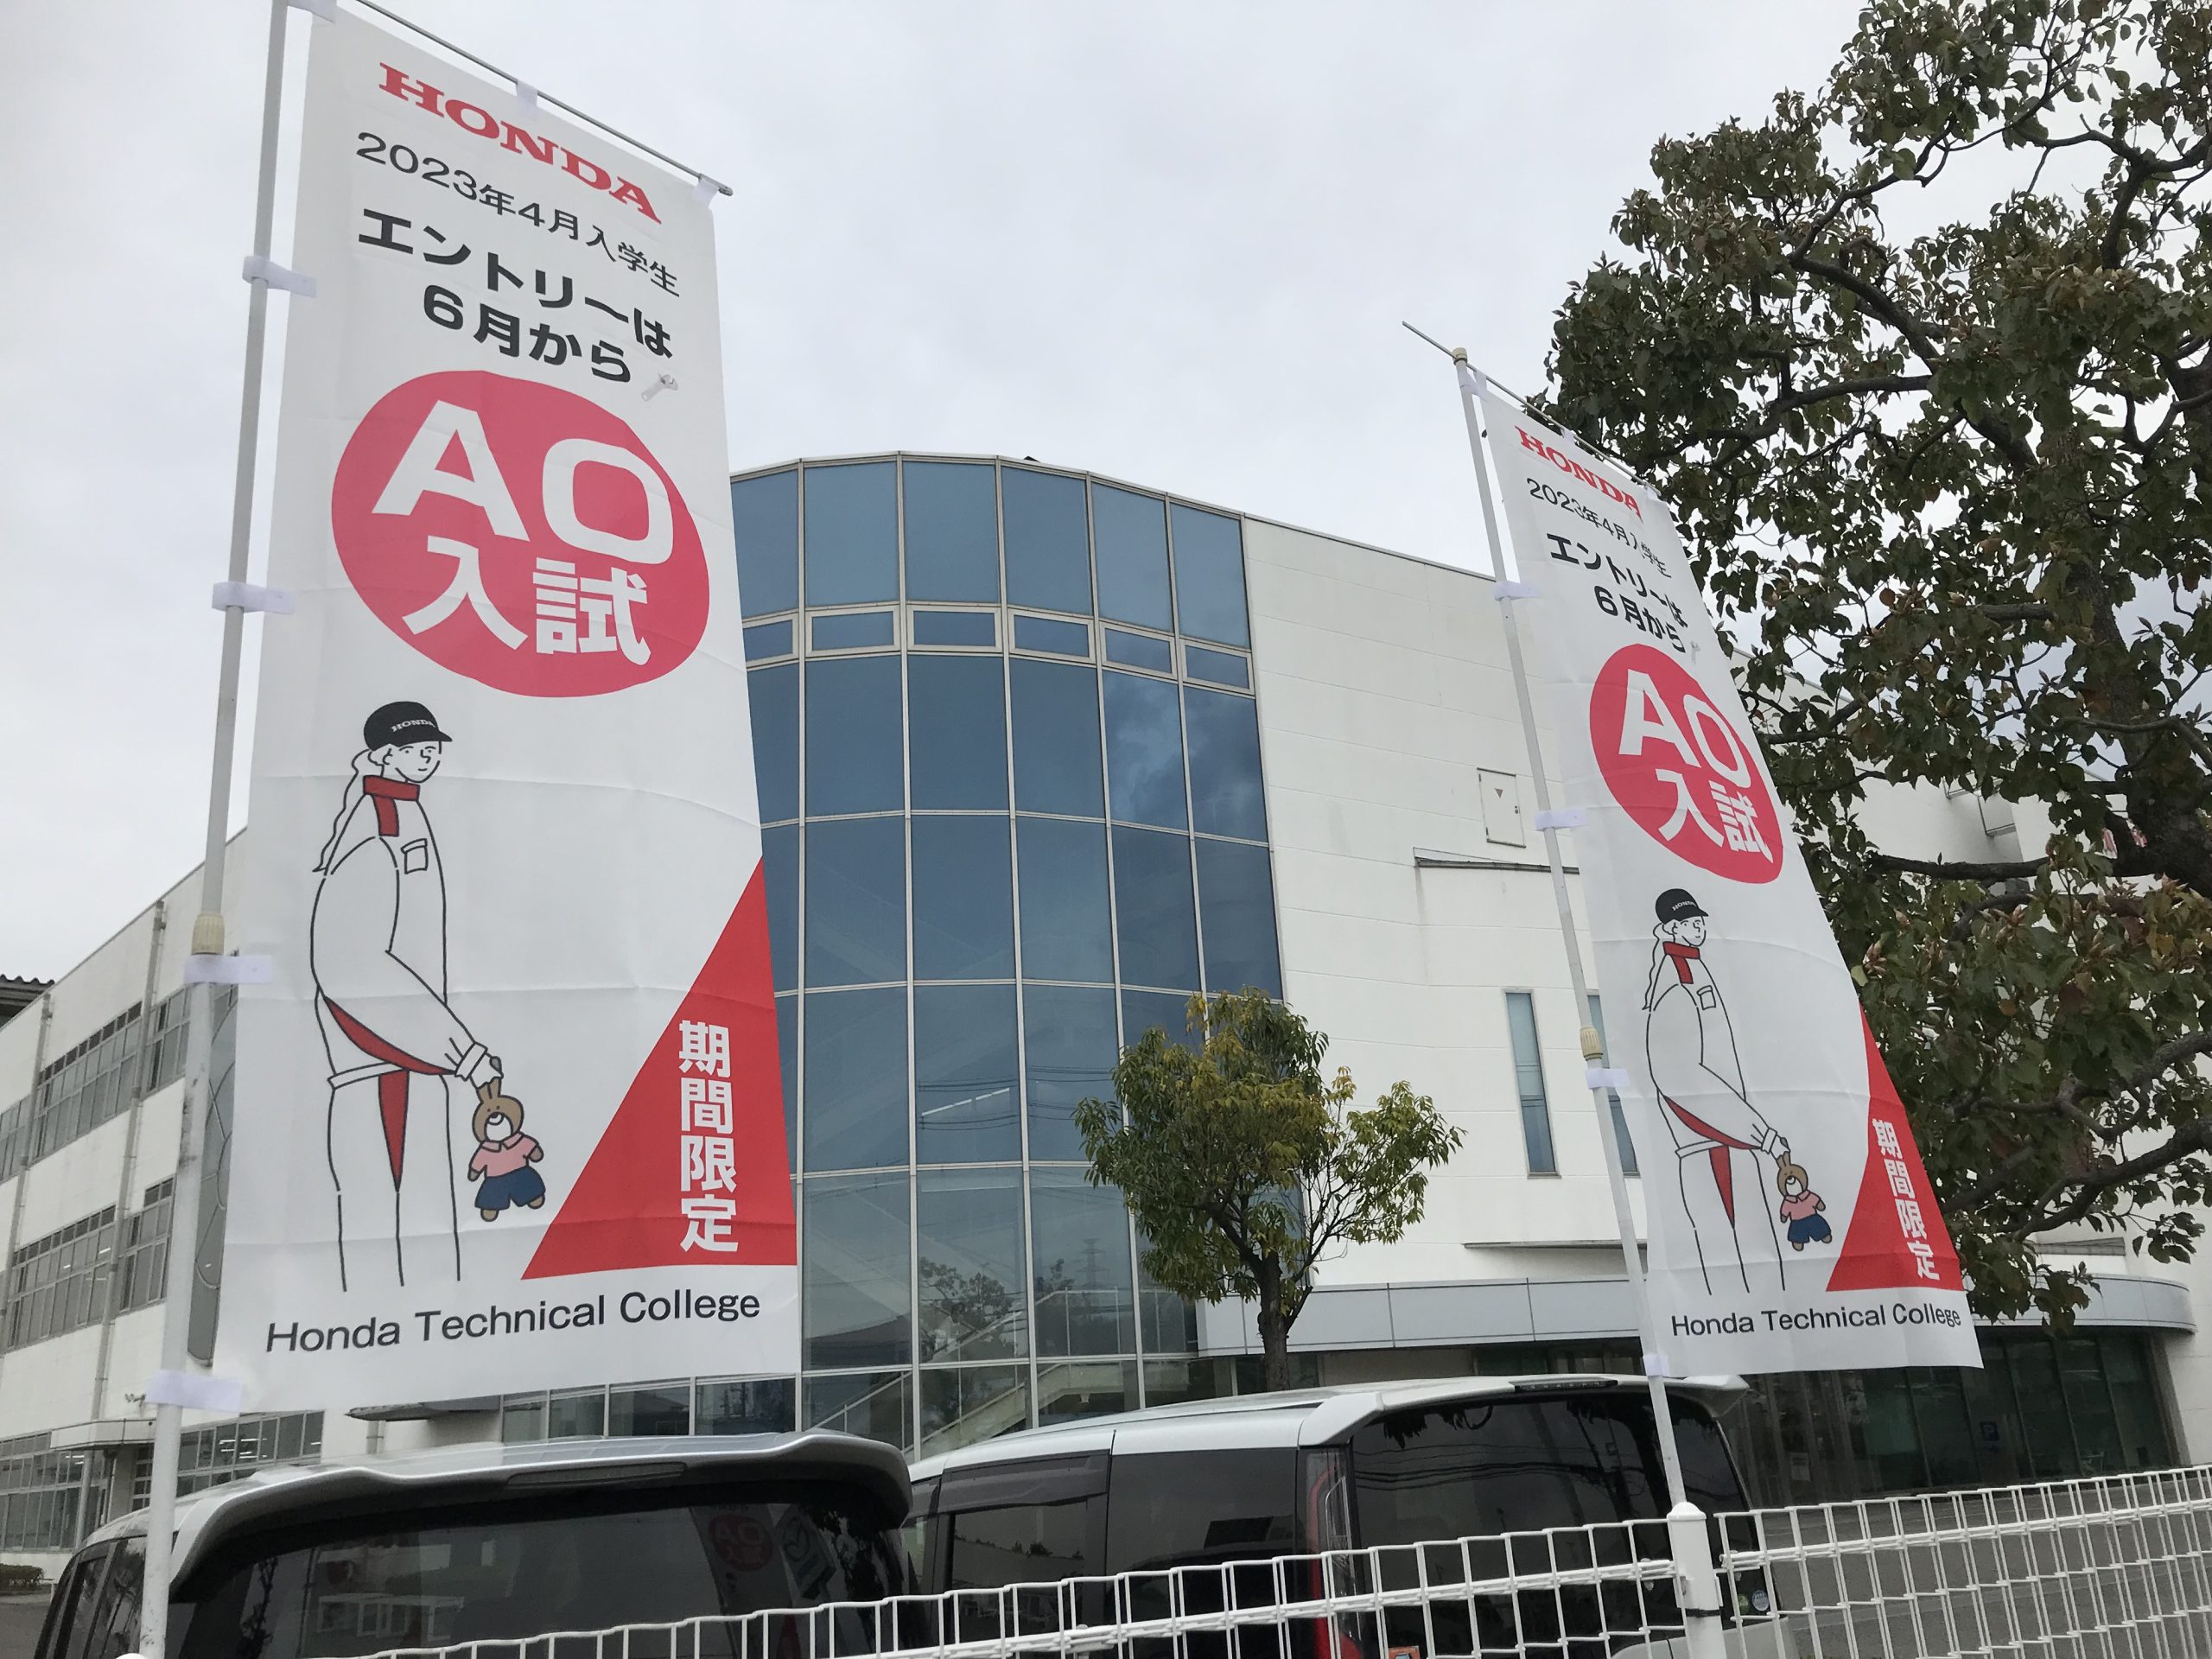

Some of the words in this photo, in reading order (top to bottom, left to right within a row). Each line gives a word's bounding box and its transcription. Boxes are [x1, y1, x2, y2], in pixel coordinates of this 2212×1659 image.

[378, 61, 663, 225] HONDA
[355, 131, 680, 298] 2023年4月入学生
[358, 207, 674, 359] エントリーは
[423, 283, 632, 384] 6月から
[371, 399, 674, 565] AO
[1514, 425, 1644, 524] HONDA
[1526, 477, 1672, 579] 2023年4月入学生
[401, 534, 652, 666] 入試
[1546, 532, 1688, 629] エントリーは
[1593, 585, 1687, 654] 6月から
[1618, 668, 1751, 788] AO
[1655, 767, 1774, 864] 入試
[677, 1019, 740, 1254] 期間限定
[1872, 1117, 1941, 1281] 期間限定
[265, 1317, 402, 1353] Honda
[414, 1294, 606, 1343] Technical
[619, 1288, 761, 1325] College
[1671, 1312, 1755, 1337] Honda
[1761, 1304, 1886, 1332] Technical
[1891, 1303, 1961, 1329] College
